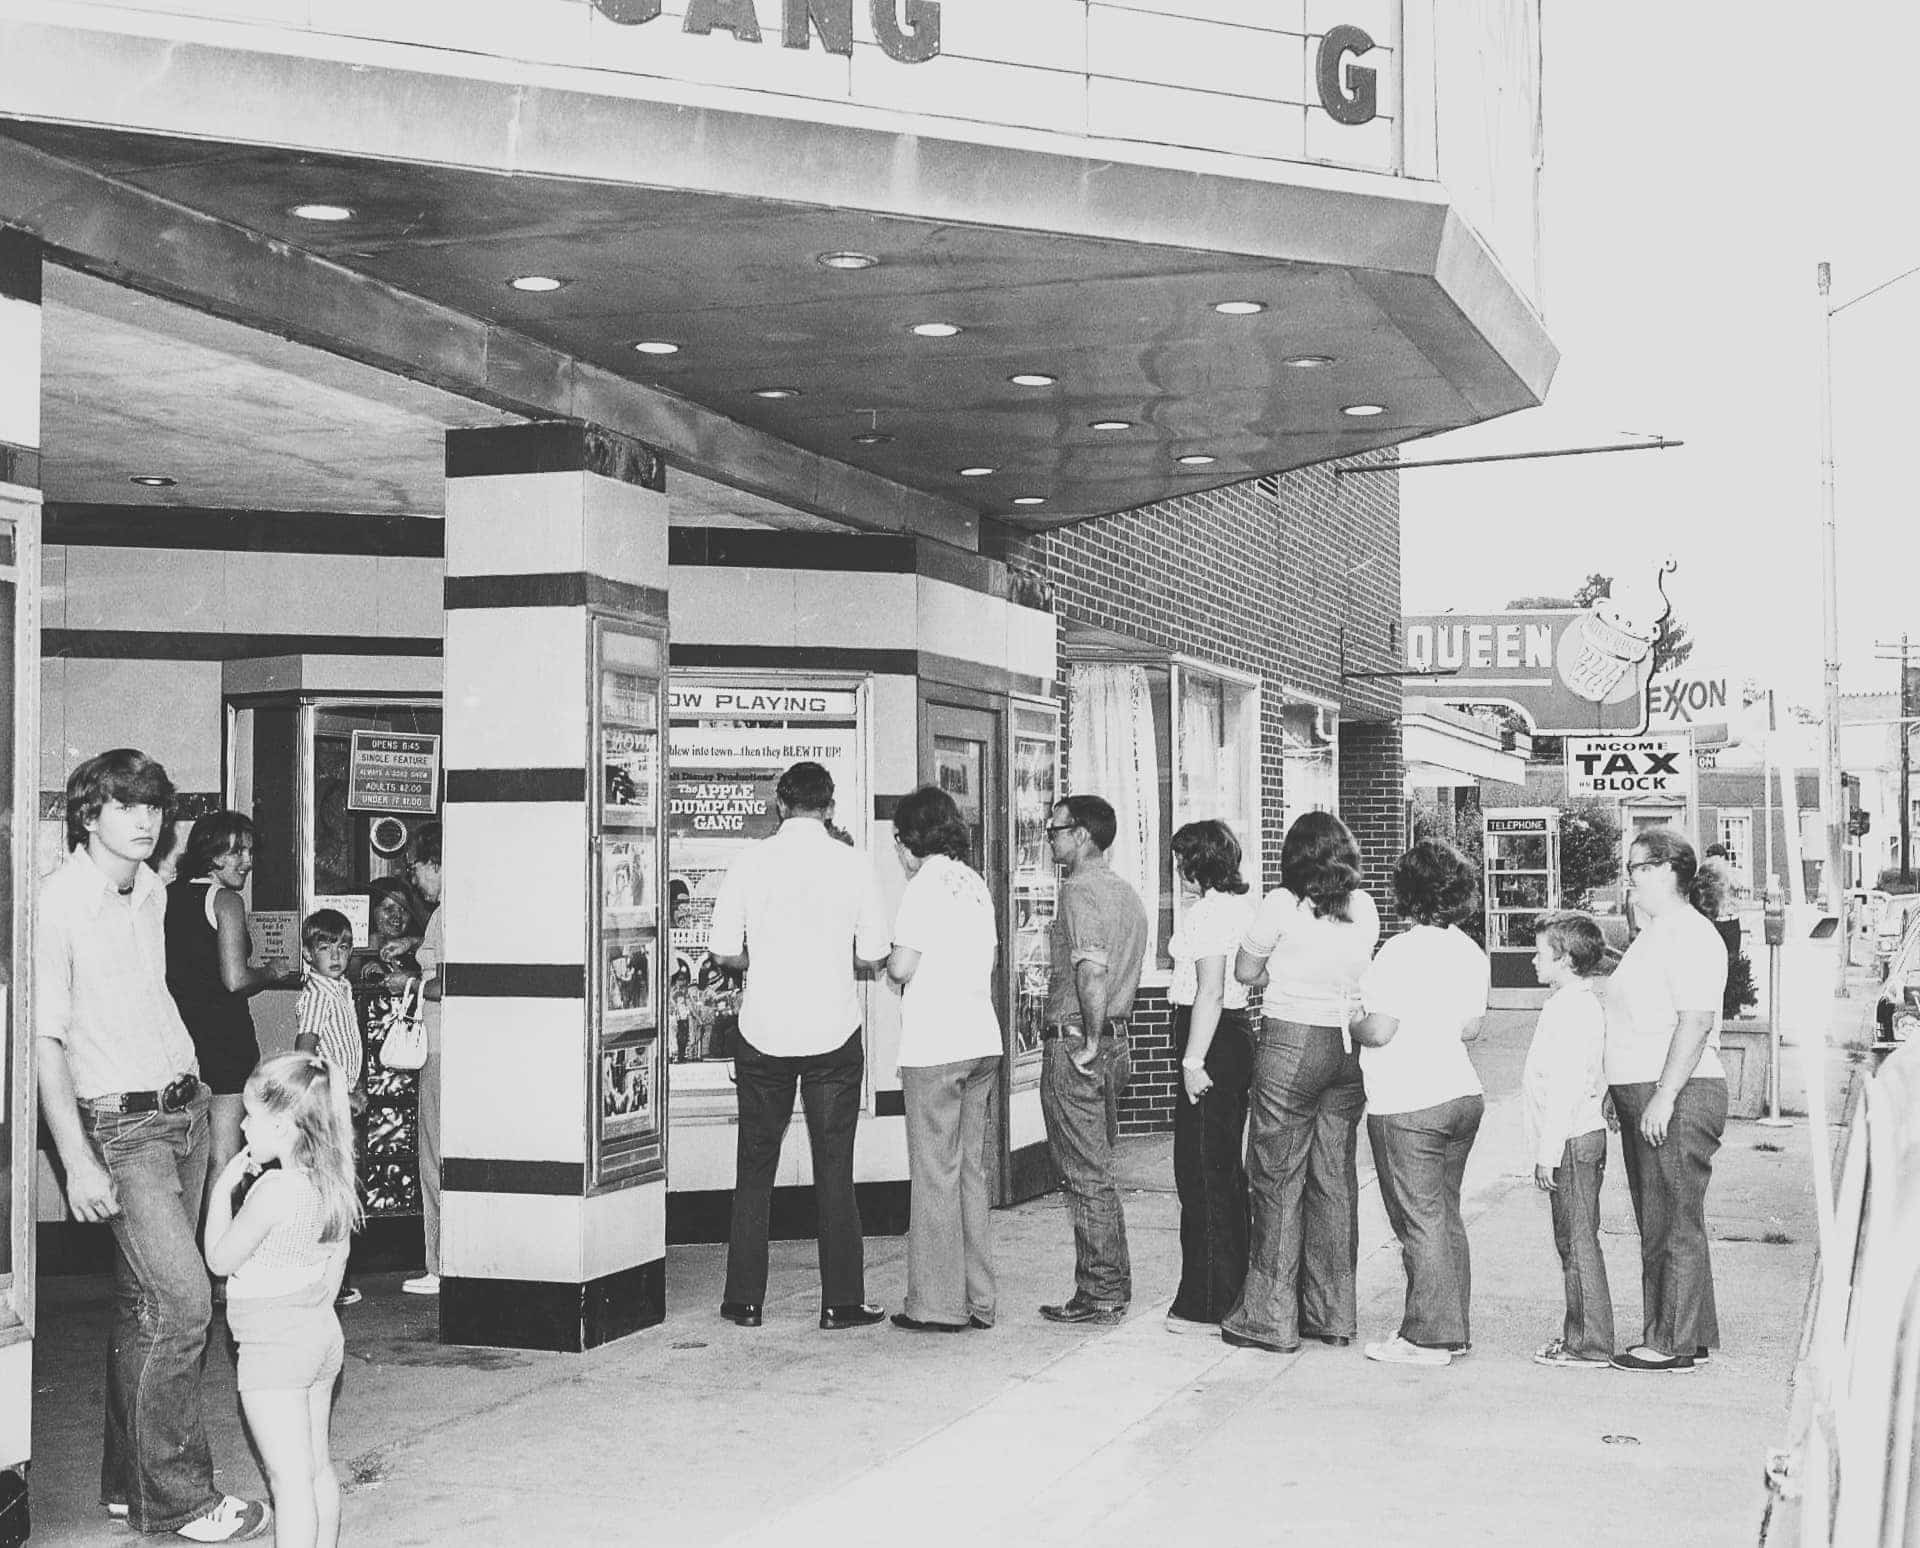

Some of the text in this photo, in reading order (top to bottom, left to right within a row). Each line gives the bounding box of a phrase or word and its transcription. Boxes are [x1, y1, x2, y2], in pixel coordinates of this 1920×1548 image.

[592, 0, 941, 64] NG
[1316, 24, 1378, 126] G
[1407, 623, 1553, 670] QUEEN
[669, 693, 827, 712] OW PLAYING
[1648, 678, 1727, 721] EXXON
[371, 740, 398, 750] OPENS
[692, 745, 709, 756] into
[762, 746, 781, 759] they
[783, 745, 810, 757] BLEW
[813, 746, 823, 757] IT
[825, 746, 842, 757] UP!
[1587, 742, 1668, 751] INCOME
[361, 753, 428, 765] SINGLE FEATURE
[1575, 752, 1680, 775] TAX
[669, 772, 680, 781] alt
[1593, 777, 1666, 790] BLOCK
[365, 782, 396, 792] ADULTS
[679, 783, 754, 799] The APPLE
[362, 794, 388, 805] UNDER
[670, 799, 767, 815] DUMPLING
[694, 815, 745, 831] GANG
[1488, 820, 1544, 830] TELEPHONE
